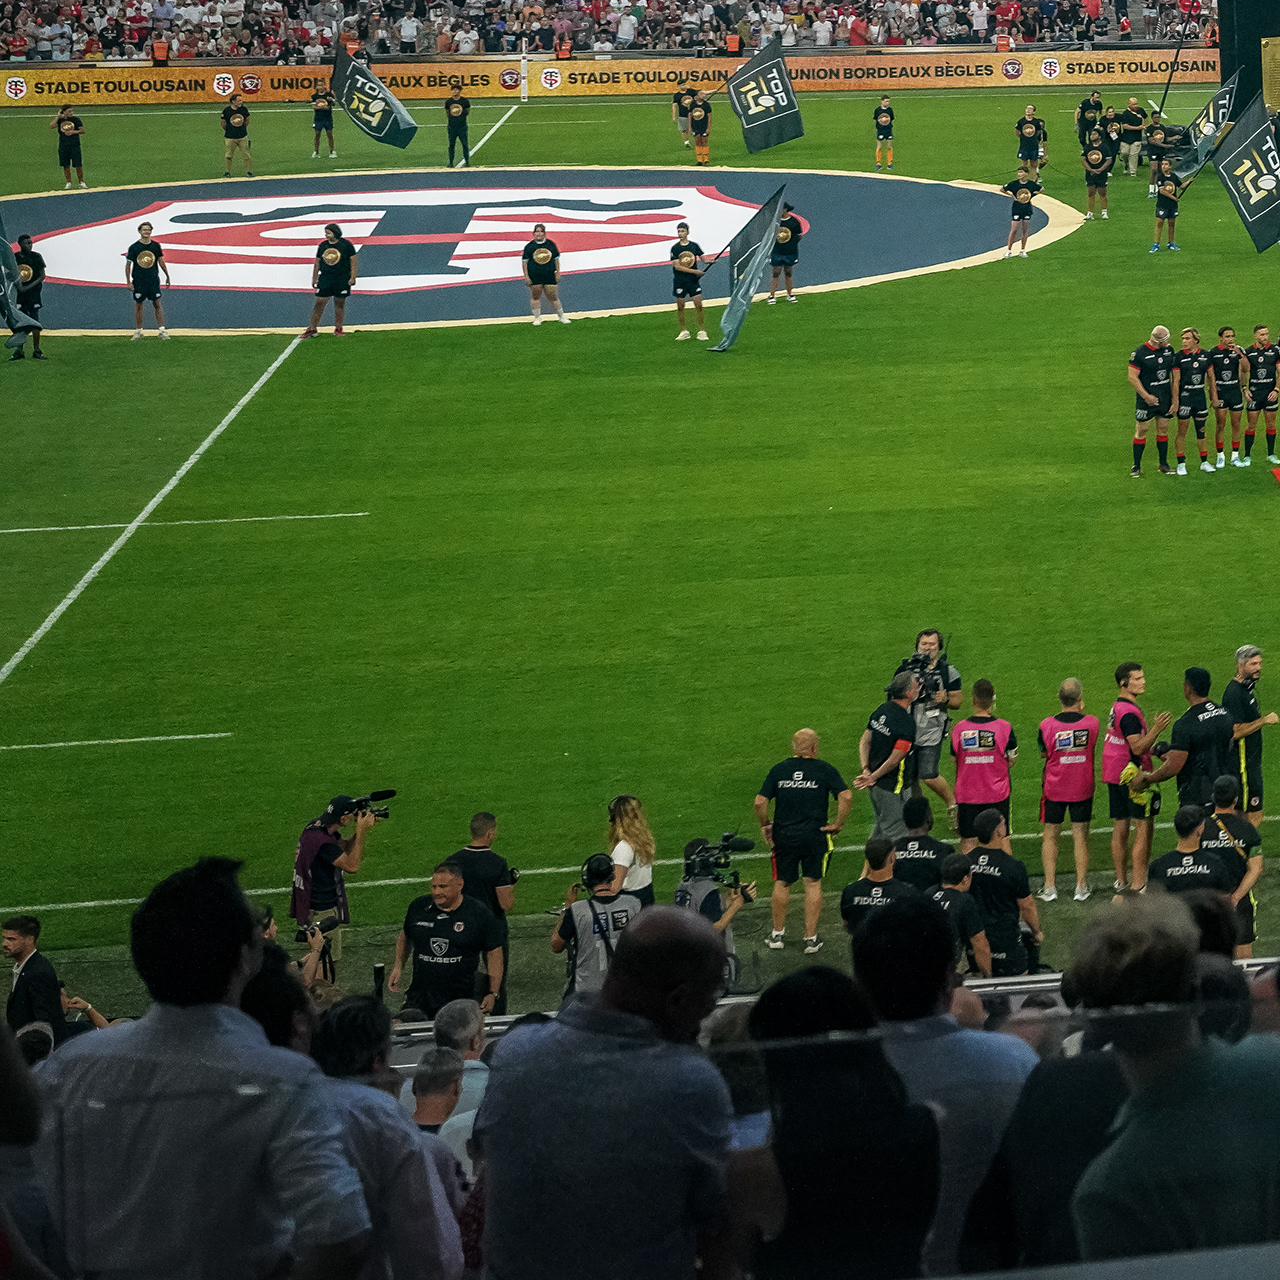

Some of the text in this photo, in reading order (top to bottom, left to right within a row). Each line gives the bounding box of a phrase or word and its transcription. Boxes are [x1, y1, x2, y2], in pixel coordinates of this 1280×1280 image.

[788, 61, 994, 80] UNION BORDEAUX BÈGLES
[1066, 60, 1217, 74] STADE TOULOUSAIN
[429, 71, 490, 88] BÈGLES
[568, 69, 729, 85] STADE TOULOUSAIN
[34, 79, 206, 95] STADE TOULOUSAIN
[777, 779, 819, 790] FIDUCIAL
[1166, 864, 1211, 878] FIDUCIAL
[853, 896, 891, 906] FIDUCI
[418, 953, 463, 964] PEUGEOT
